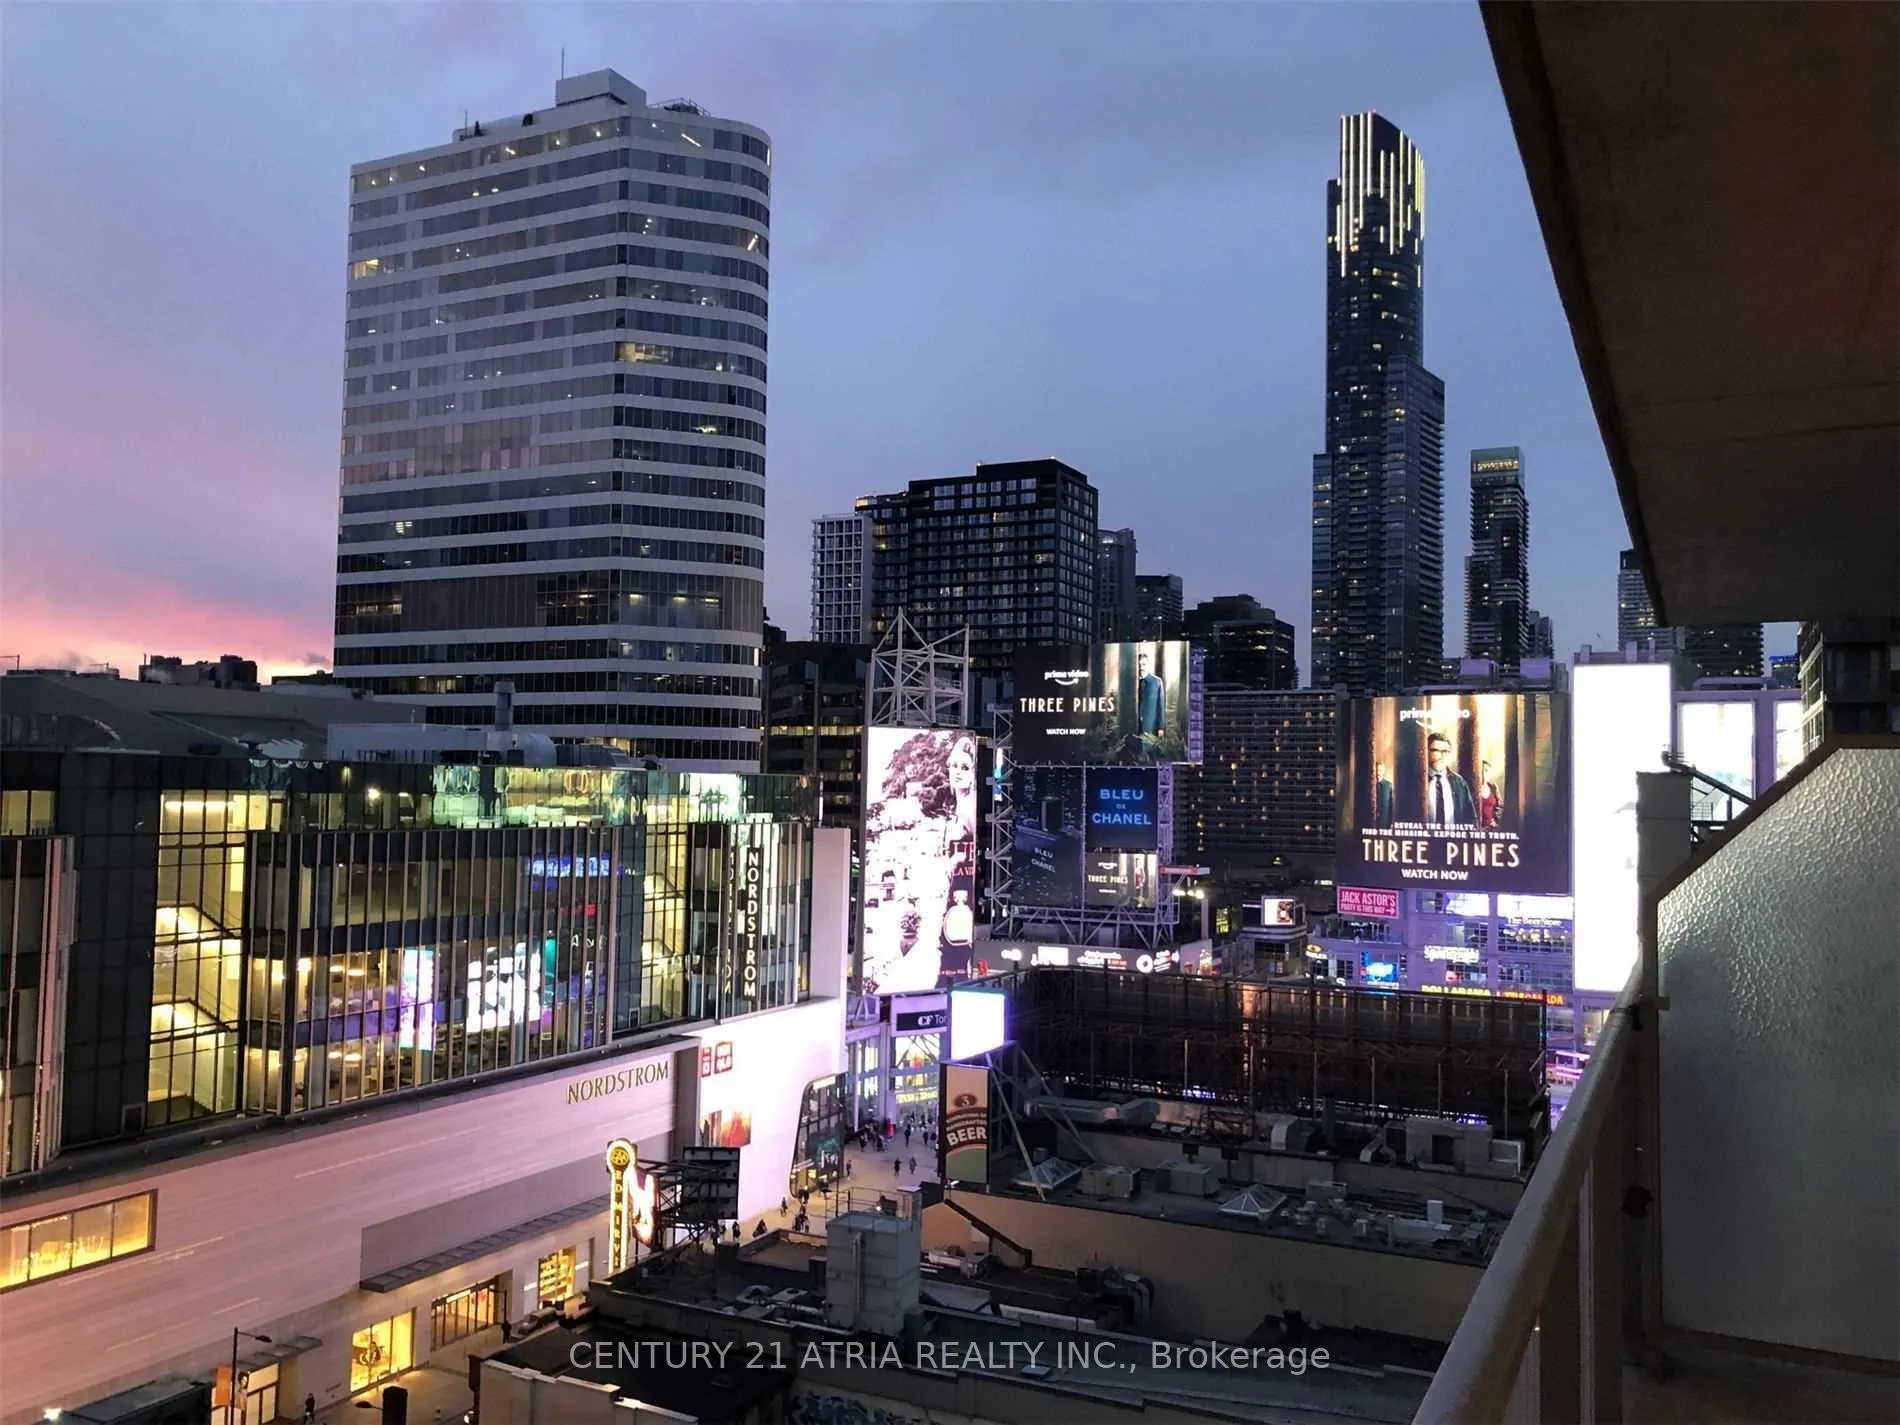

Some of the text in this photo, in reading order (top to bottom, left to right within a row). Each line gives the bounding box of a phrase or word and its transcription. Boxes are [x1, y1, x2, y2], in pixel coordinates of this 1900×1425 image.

[1020, 697, 1115, 713] THREE PINES
[1100, 788, 1144, 800] BLEU
[1092, 812, 1152, 825] CHANEL
[1362, 838, 1520, 867] THREE PINES
[1401, 868, 1468, 880] WATCH NOW
[1341, 890, 1396, 907] JACK ASTOR'S
[744, 851, 760, 997] NORDSTROM
[567, 1060, 669, 1105] NORDSTROM
[946, 1126, 988, 1146] BEER
